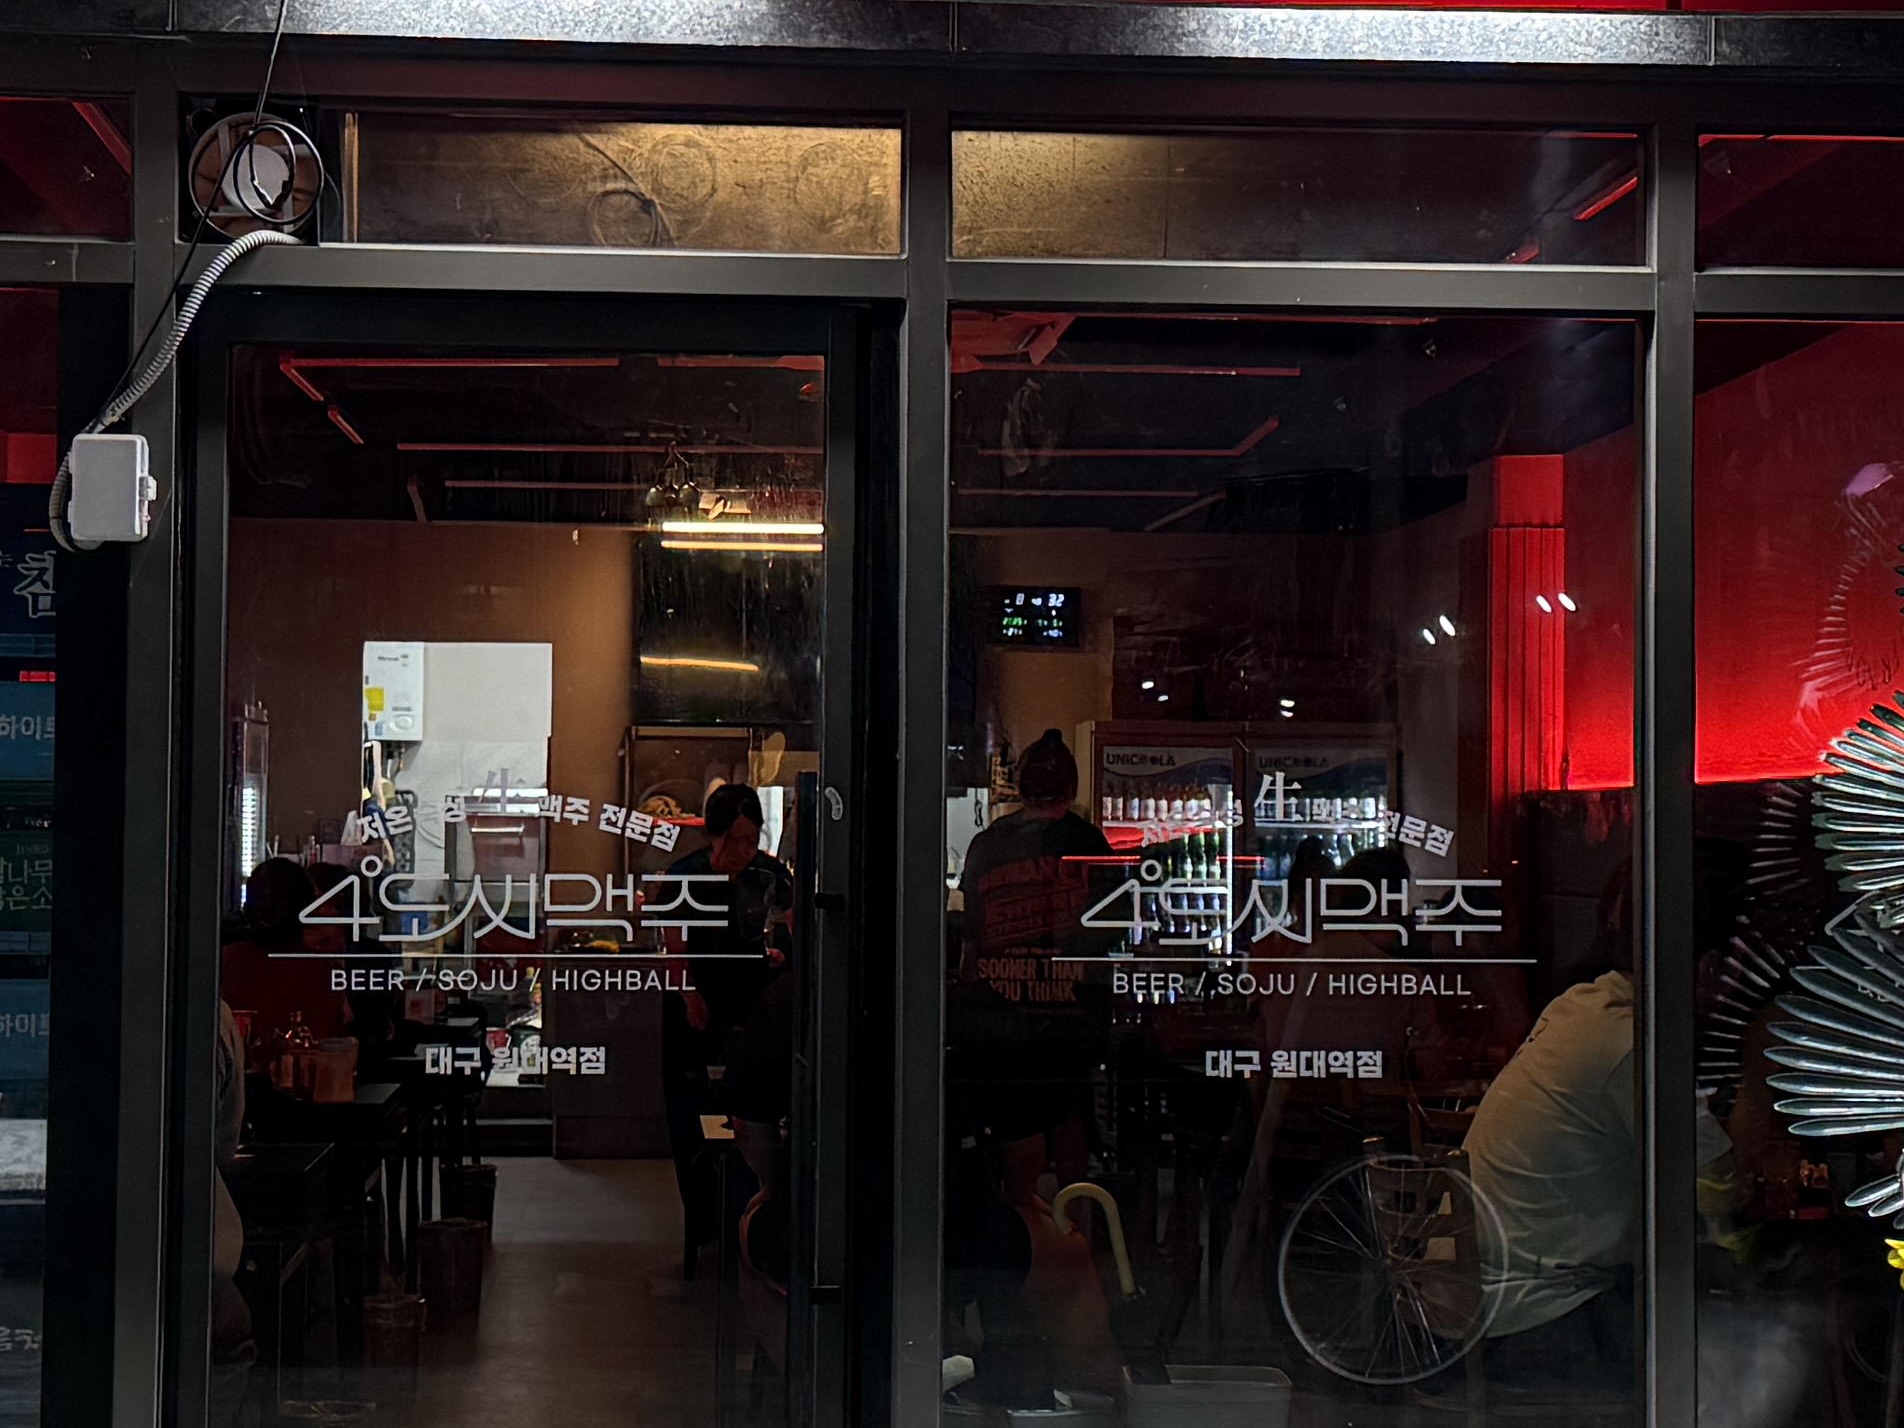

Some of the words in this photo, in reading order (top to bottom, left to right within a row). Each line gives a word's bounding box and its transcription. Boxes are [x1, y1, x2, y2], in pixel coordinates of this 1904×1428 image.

[1255, 772, 1303, 822] 生
[357, 795, 467, 844] 저온성
[539, 795, 590, 825] 맥주
[599, 803, 680, 852] 전문점
[332, 969, 405, 992] BEER
[438, 969, 517, 992] SOJU
[552, 969, 696, 992] HIGHBALL
[1113, 973, 1185, 996] BEER
[1218, 973, 1295, 996] SOJU
[1329, 973, 1471, 996] HIGHBALL
[425, 1046, 481, 1075] 대구
[491, 1046, 606, 1076] 원대역점
[1205, 1050, 1261, 1078] 대구
[1270, 1050, 1383, 1079] 원대역점
